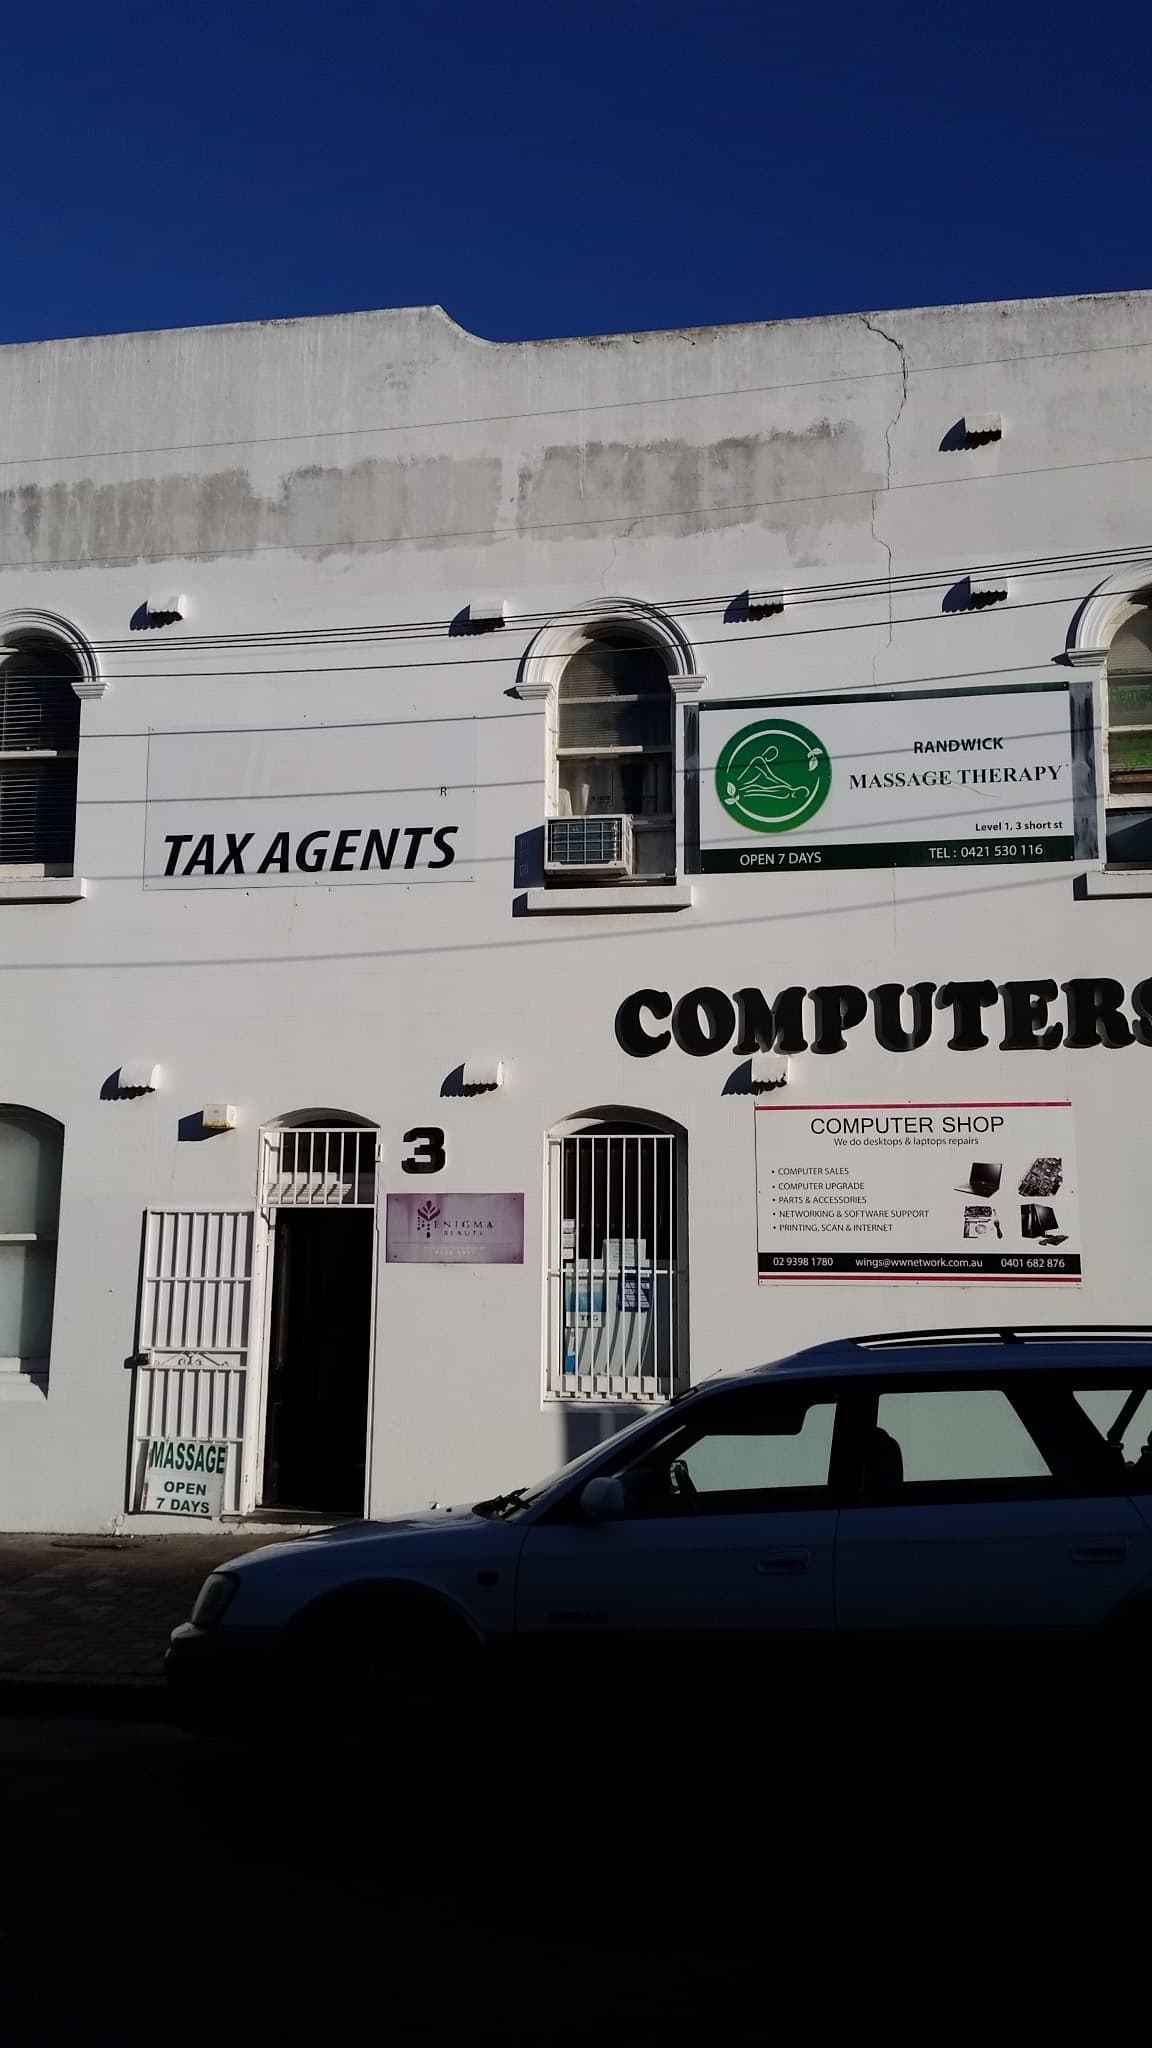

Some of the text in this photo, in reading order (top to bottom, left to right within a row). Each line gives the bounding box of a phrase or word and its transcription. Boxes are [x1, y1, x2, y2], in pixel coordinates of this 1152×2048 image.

[914, 737, 1003, 753] RANDWICK
[850, 766, 1061, 789] MASSAGE THERAPY
[440, 787, 447, 796] R
[975, 820, 1062, 833] Level 1, 3 short st
[164, 826, 458, 876] TAX AGENTS
[929, 848, 951, 859] TEL
[961, 846, 990, 857] 0421
[994, 845, 1017, 857] 530
[1021, 844, 1042, 855] 116
[740, 852, 821, 866] OPEN 7 DAYS
[811, 1117, 1004, 1134] COMPUTER SHOP
[864, 1138, 902, 1147] desktops
[905, 1137, 911, 1145] &
[914, 1137, 946, 1147] laptops
[949, 1137, 978, 1146] repairs
[402, 1127, 446, 1174] 3
[434, 1220, 493, 1228] ENIGMA
[780, 1224, 819, 1232] PRINTING,
[787, 1257, 808, 1265] 9398
[812, 1258, 833, 1266] 1780
[856, 1258, 982, 1268] wings@wwnetwork.com.au
[1001, 1259, 1065, 1267] 0401 682 876
[150, 1441, 226, 1473] MASSAGE
[164, 1481, 207, 1495] OPEN
[156, 1498, 209, 1513] 7 DAYS
